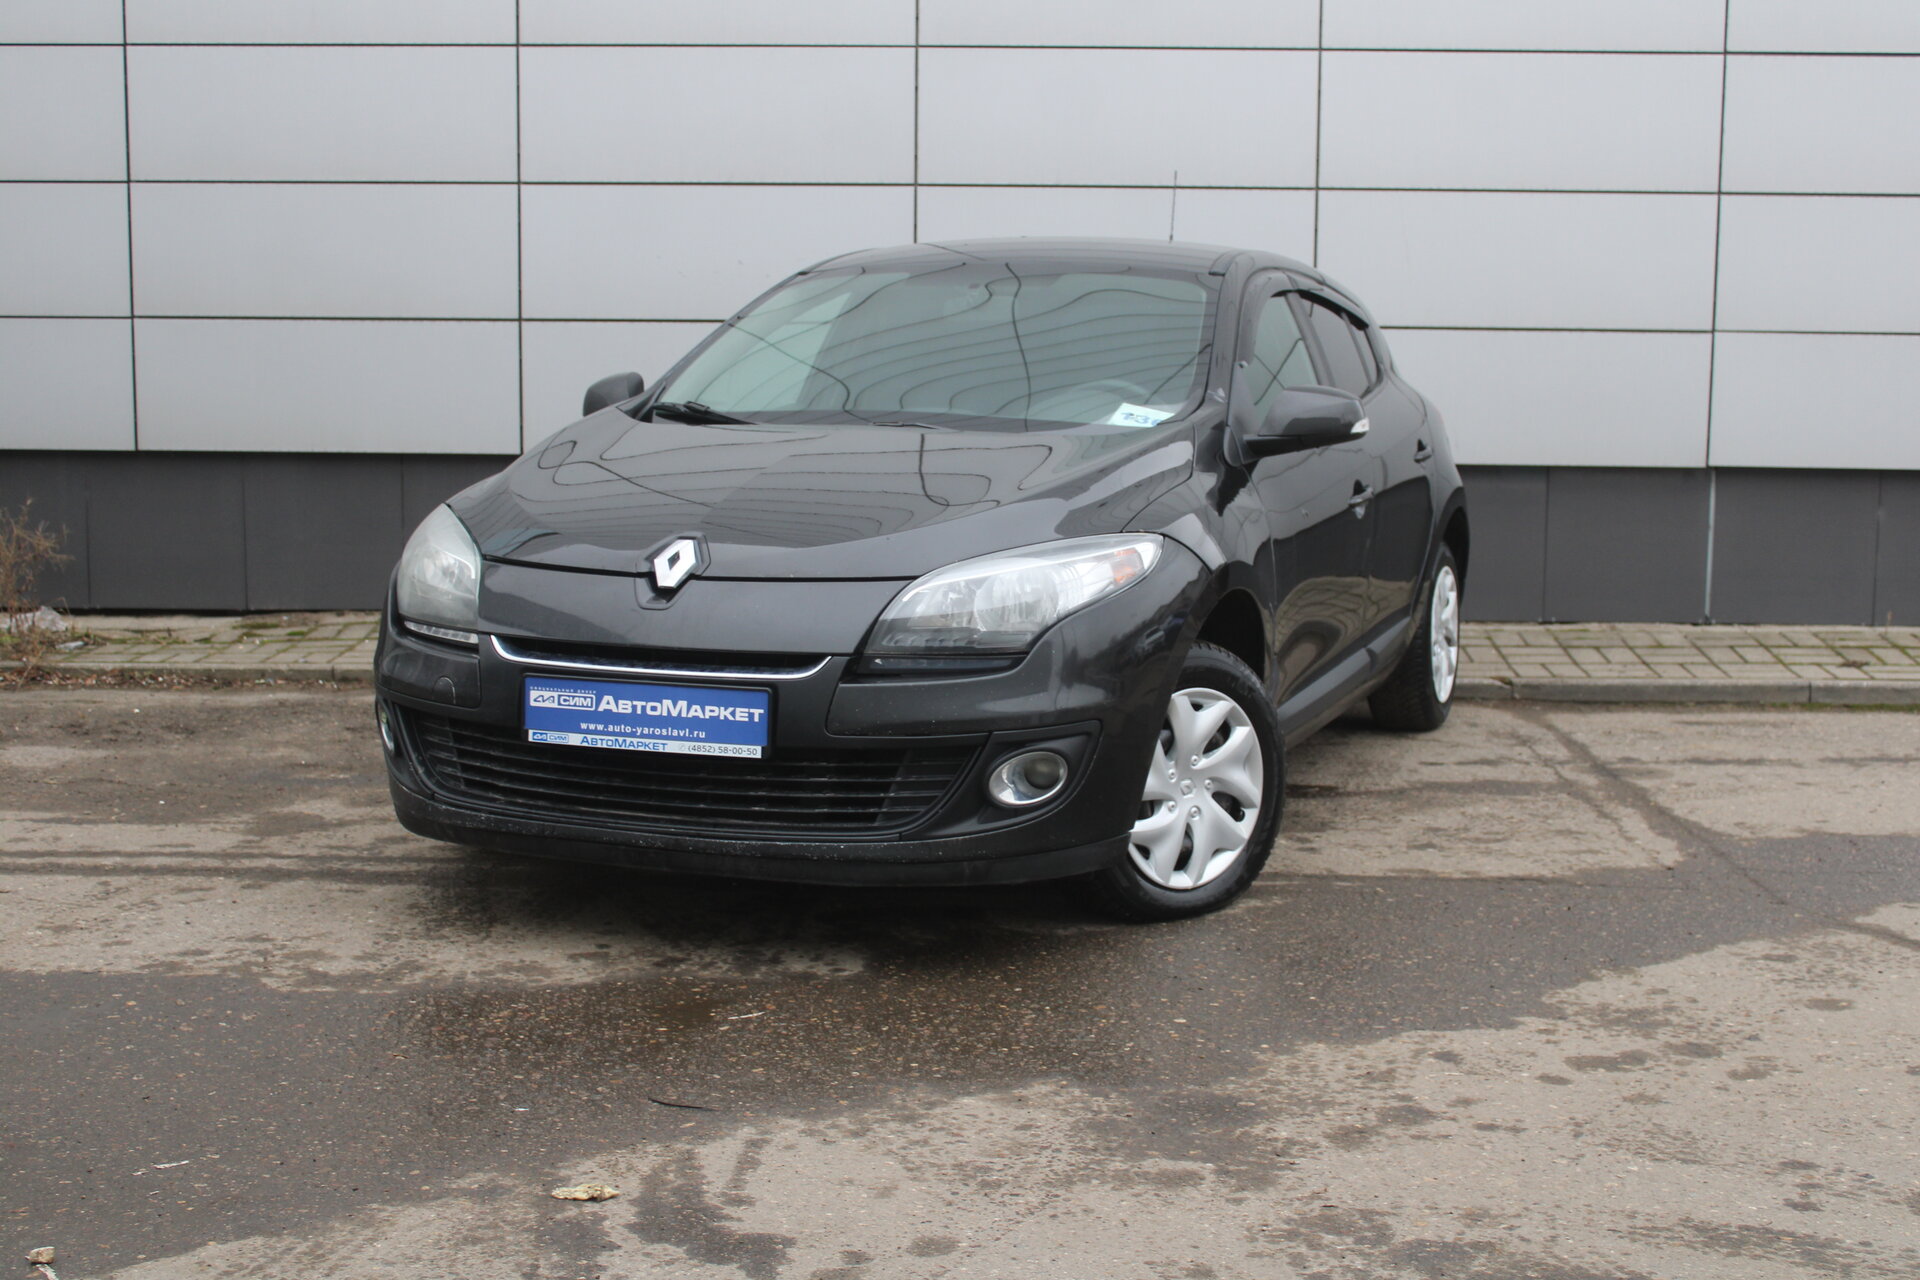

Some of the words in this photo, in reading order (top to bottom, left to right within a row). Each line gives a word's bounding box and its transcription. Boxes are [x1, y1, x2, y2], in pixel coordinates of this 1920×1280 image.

[560, 695, 592, 707] СИМ
[580, 722, 706, 738] www.auto-yaroslavl.ru
[688, 744, 716, 753] (4852)
